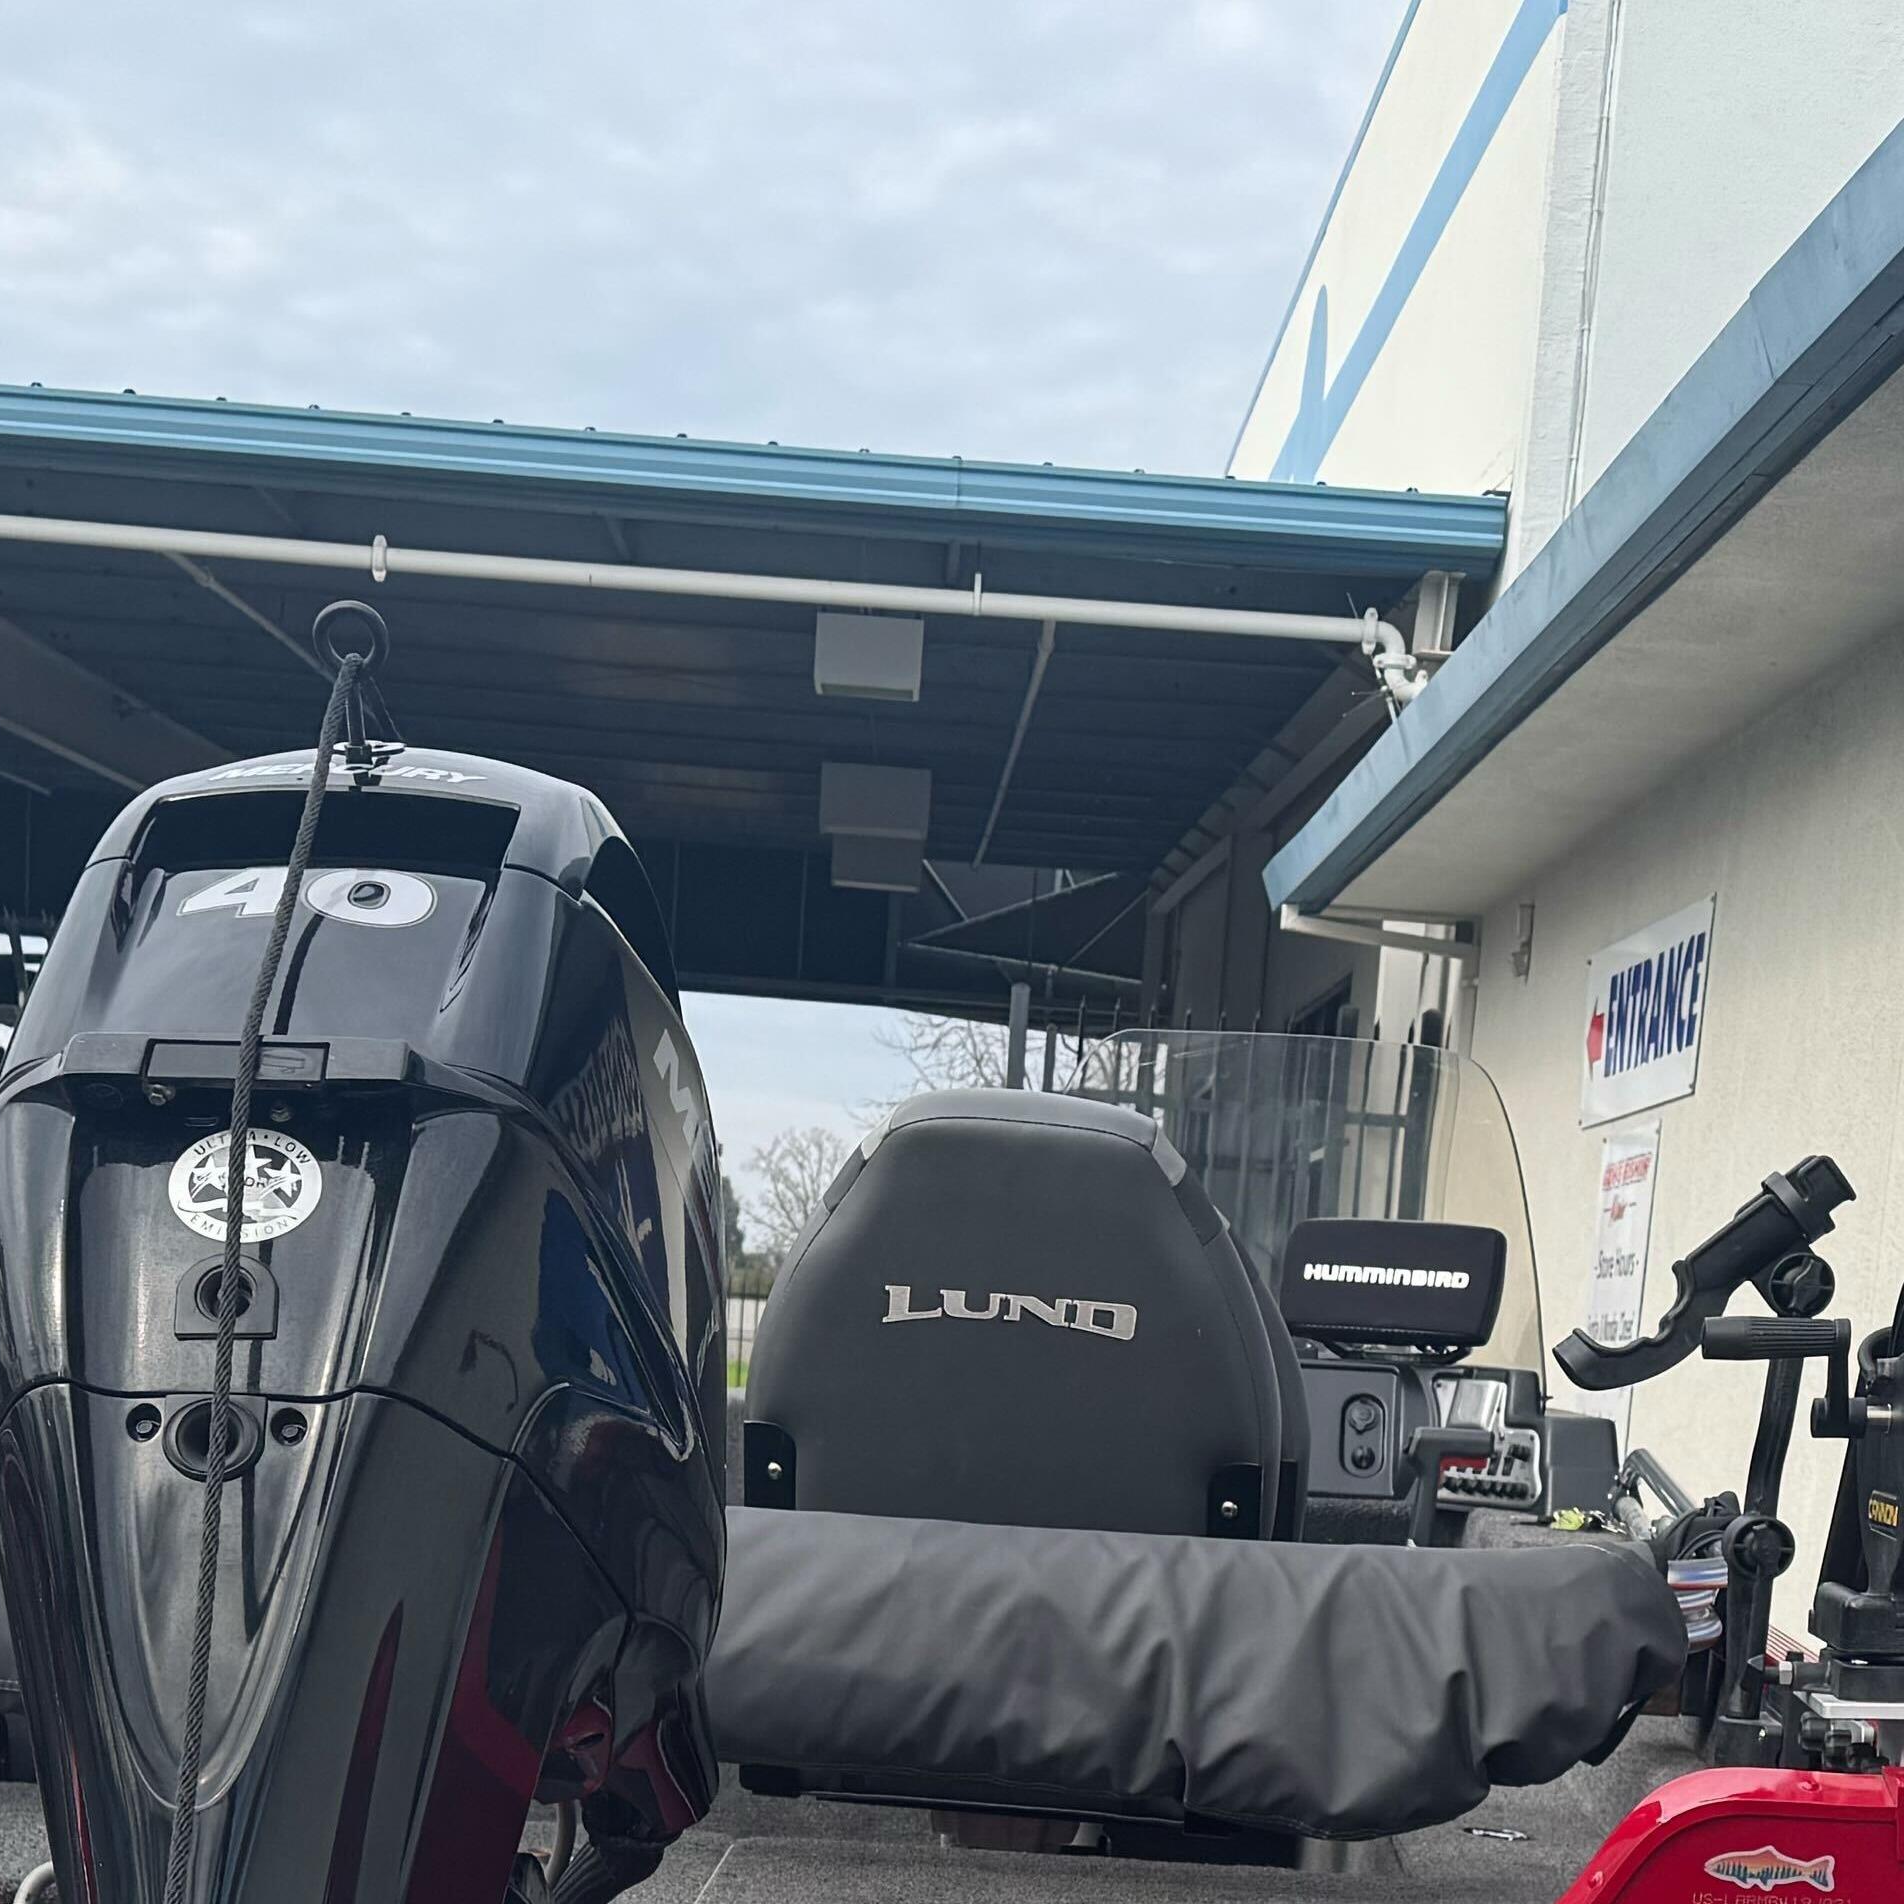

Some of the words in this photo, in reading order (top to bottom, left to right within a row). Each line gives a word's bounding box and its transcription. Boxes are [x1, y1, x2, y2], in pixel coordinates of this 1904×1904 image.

[176, 865, 438, 929] 40
[1604, 931, 1706, 1078] ENTRANCE
[273, 1136, 312, 1165] LOW
[1304, 1262, 1471, 1290] HUMMINBIRD
[882, 1284, 1138, 1342] LUND
